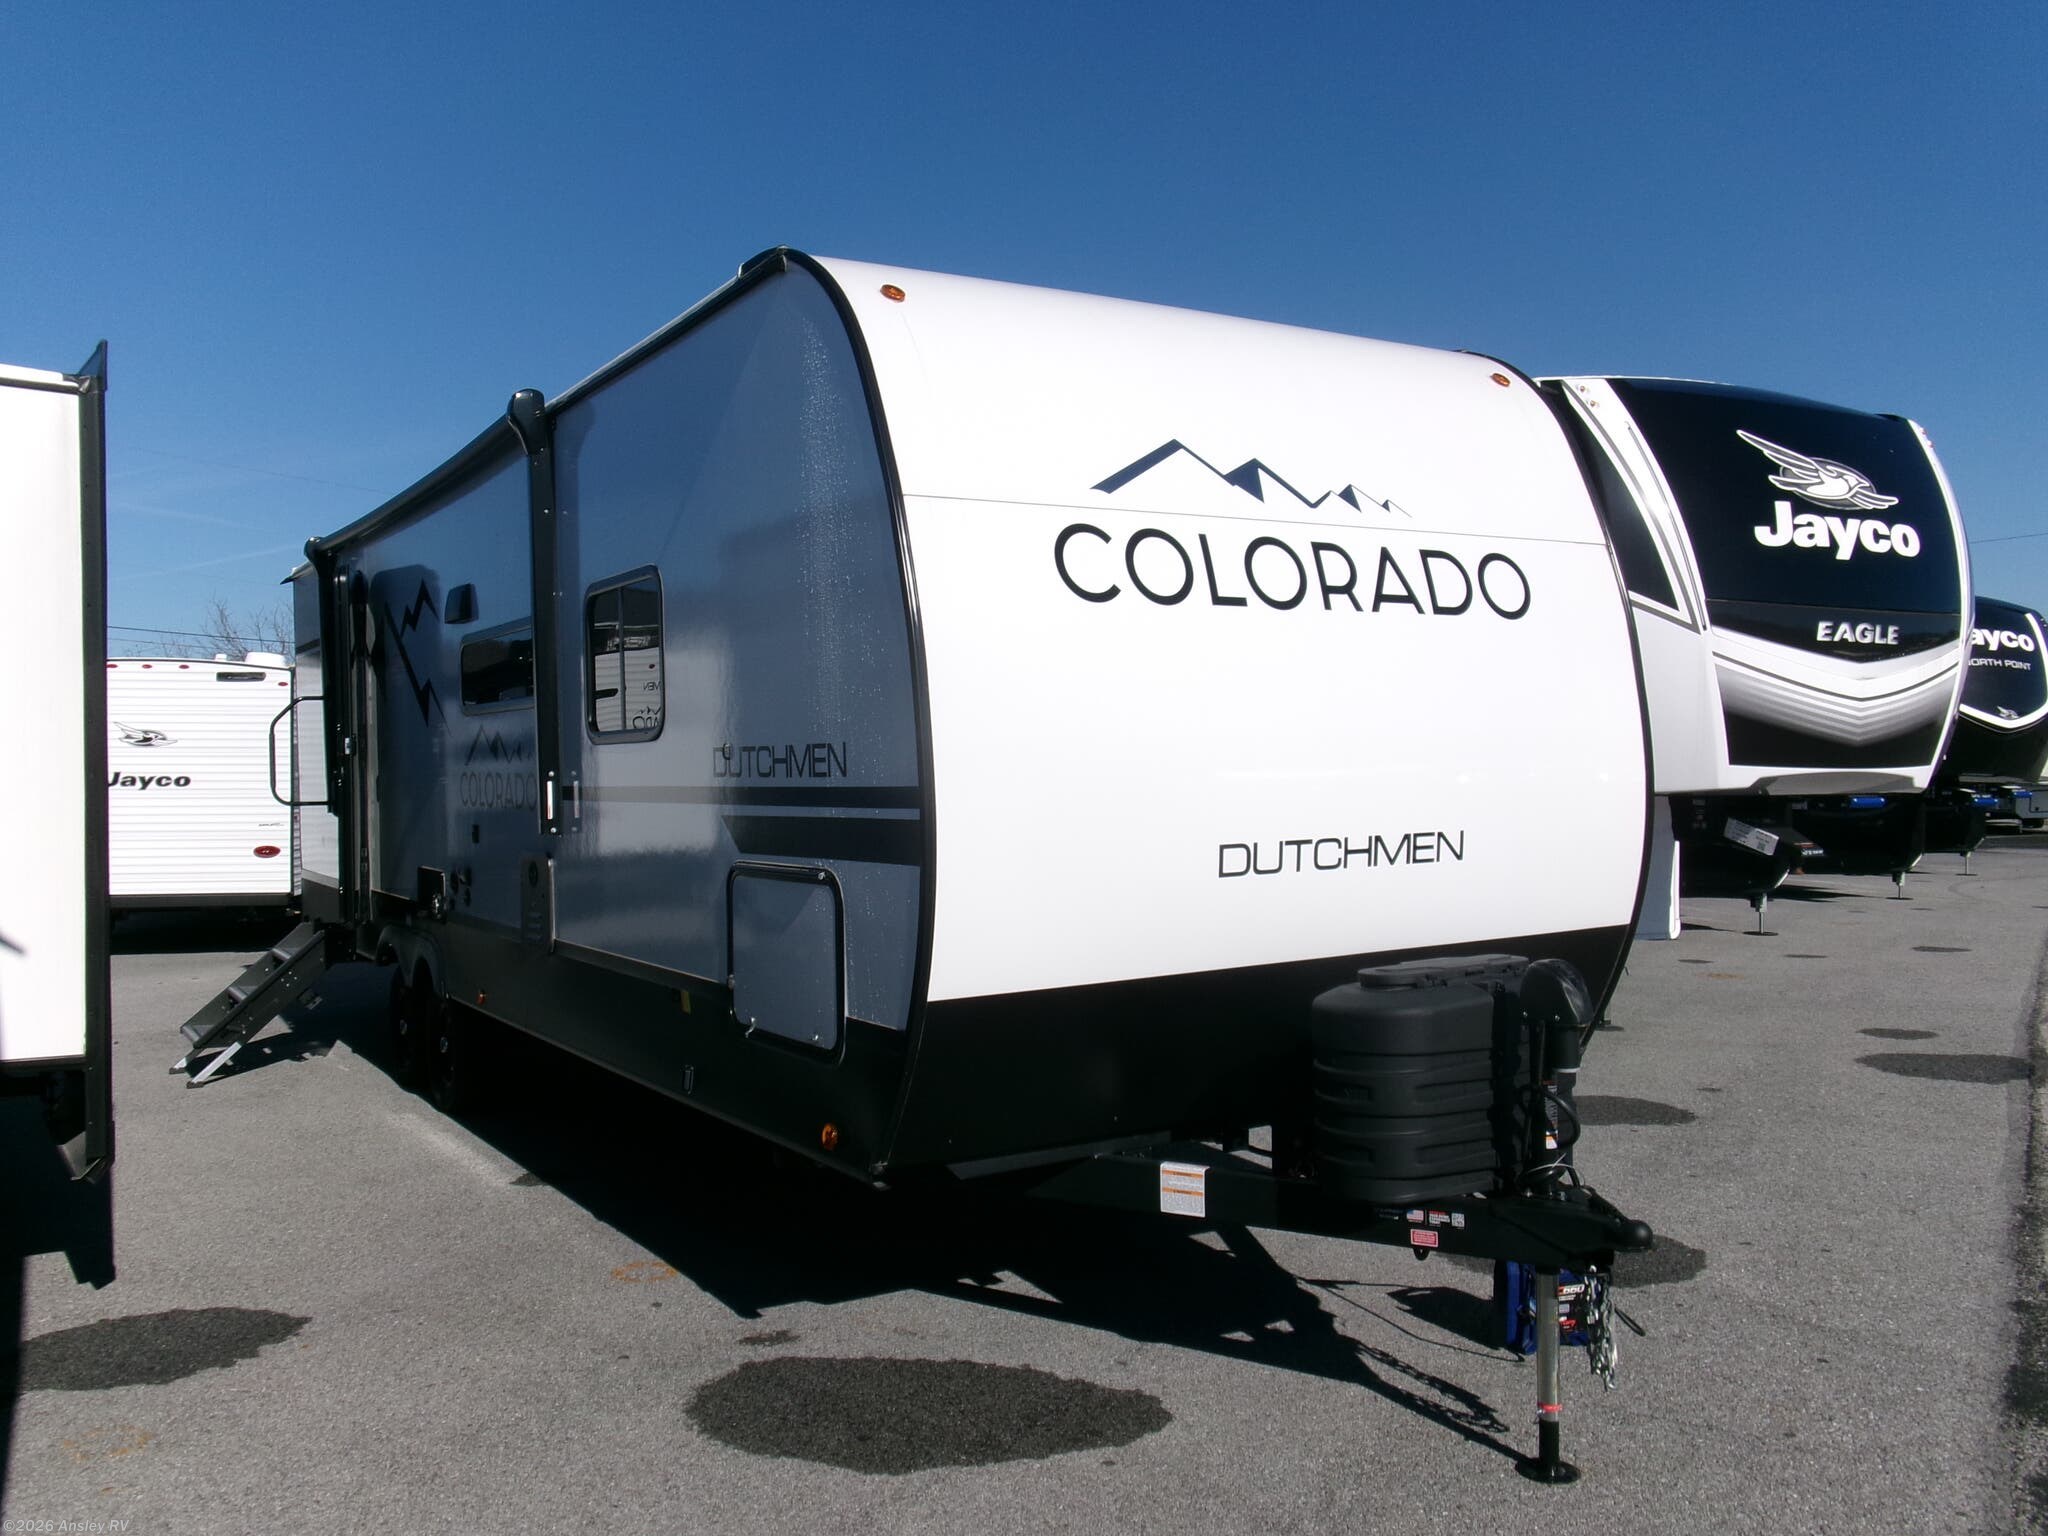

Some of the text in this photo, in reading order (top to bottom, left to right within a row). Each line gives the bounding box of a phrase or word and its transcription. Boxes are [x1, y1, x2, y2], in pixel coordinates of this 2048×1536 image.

[1754, 500, 1921, 560] Jayco
[1054, 522, 1531, 620] COLORADO
[1816, 621, 1900, 645] EAGLE
[1971, 628, 2035, 652] ayco
[2004, 660, 2032, 671] POINT
[713, 742, 848, 778] DUTCHMEN
[108, 772, 191, 790] Jayco
[460, 771, 538, 810] COLORADO
[1218, 830, 1464, 878] DUTCHMEN
